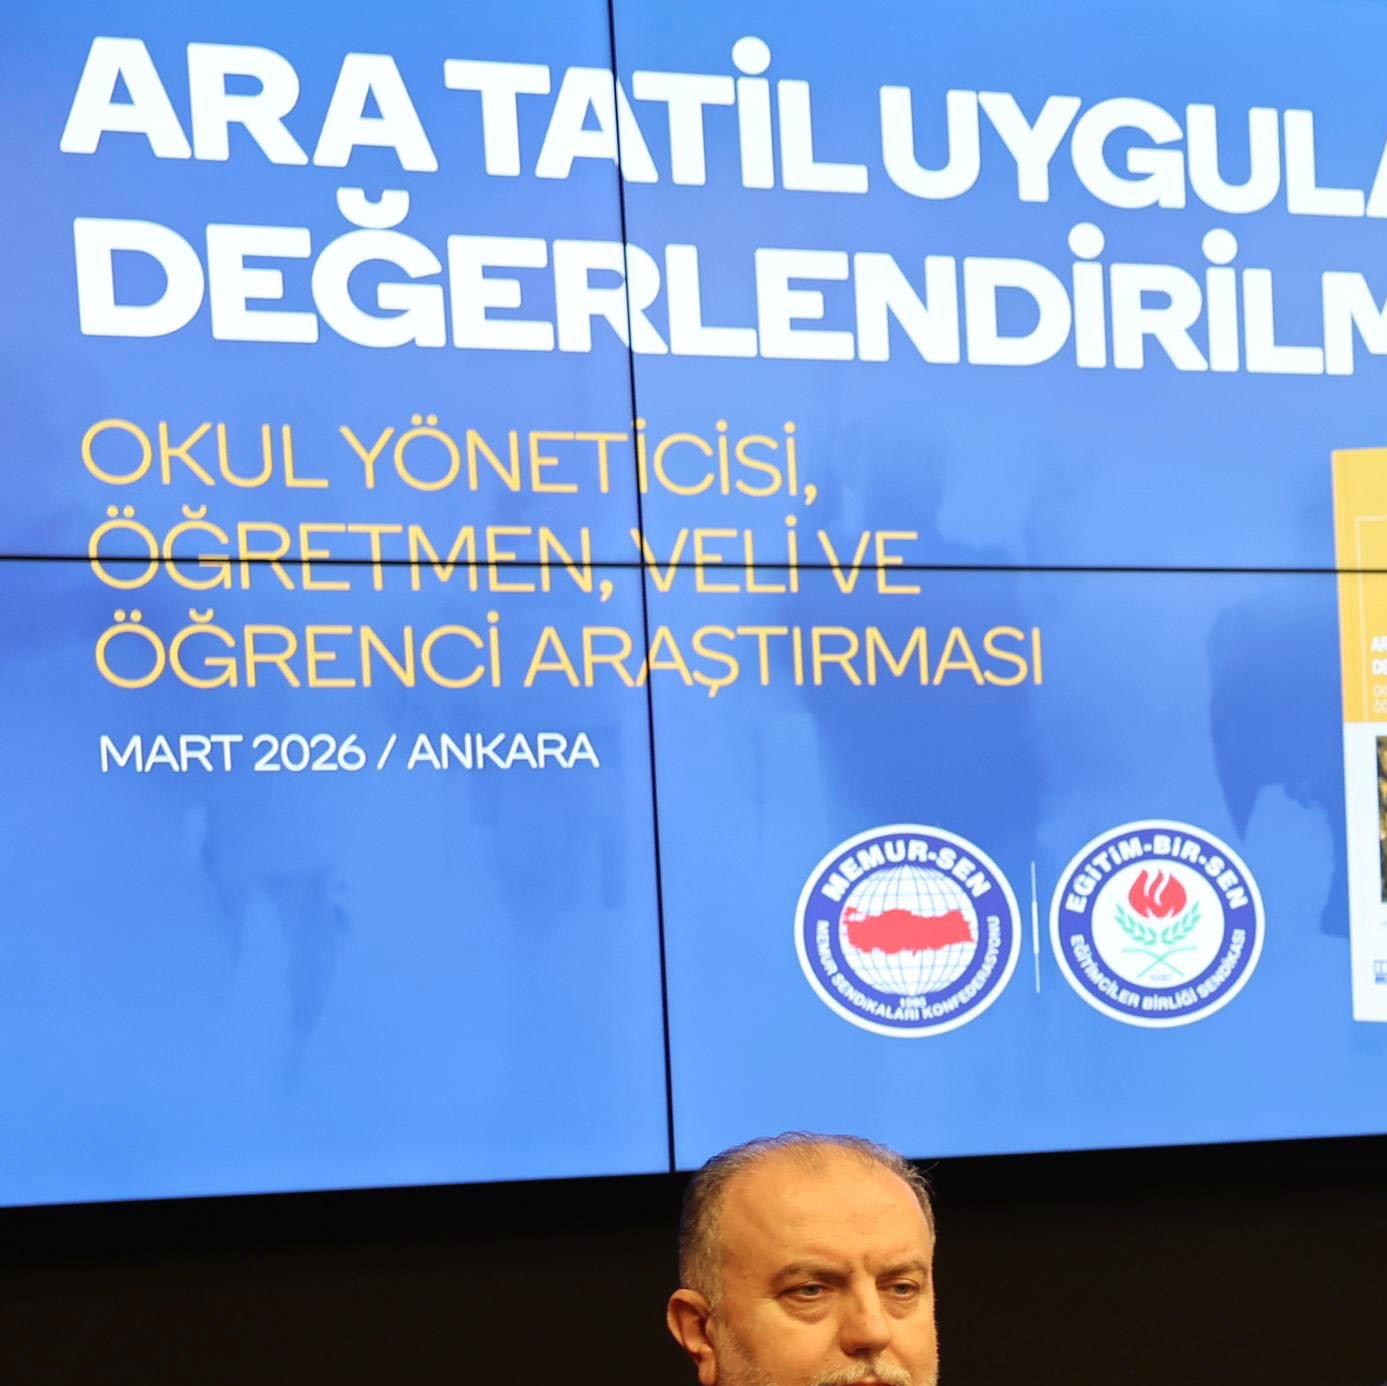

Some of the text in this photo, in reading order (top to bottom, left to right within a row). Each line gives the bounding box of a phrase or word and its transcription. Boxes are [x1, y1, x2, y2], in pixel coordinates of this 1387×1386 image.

[60, 36, 438, 172] ARA
[444, 36, 868, 194] TATİL
[82, 413, 817, 506] OKUL YÖNETİCİSİ,
[88, 505, 921, 601] ÖĞRETMEN, VELİ VE
[94, 609, 1044, 698] ÖĞRENCİ ARAŞTIRMASI
[100, 732, 599, 773] MART 2026 / ANKARA
[821, 839, 992, 902] MEMUR-SEN
[816, 920, 838, 976] MEMUR
